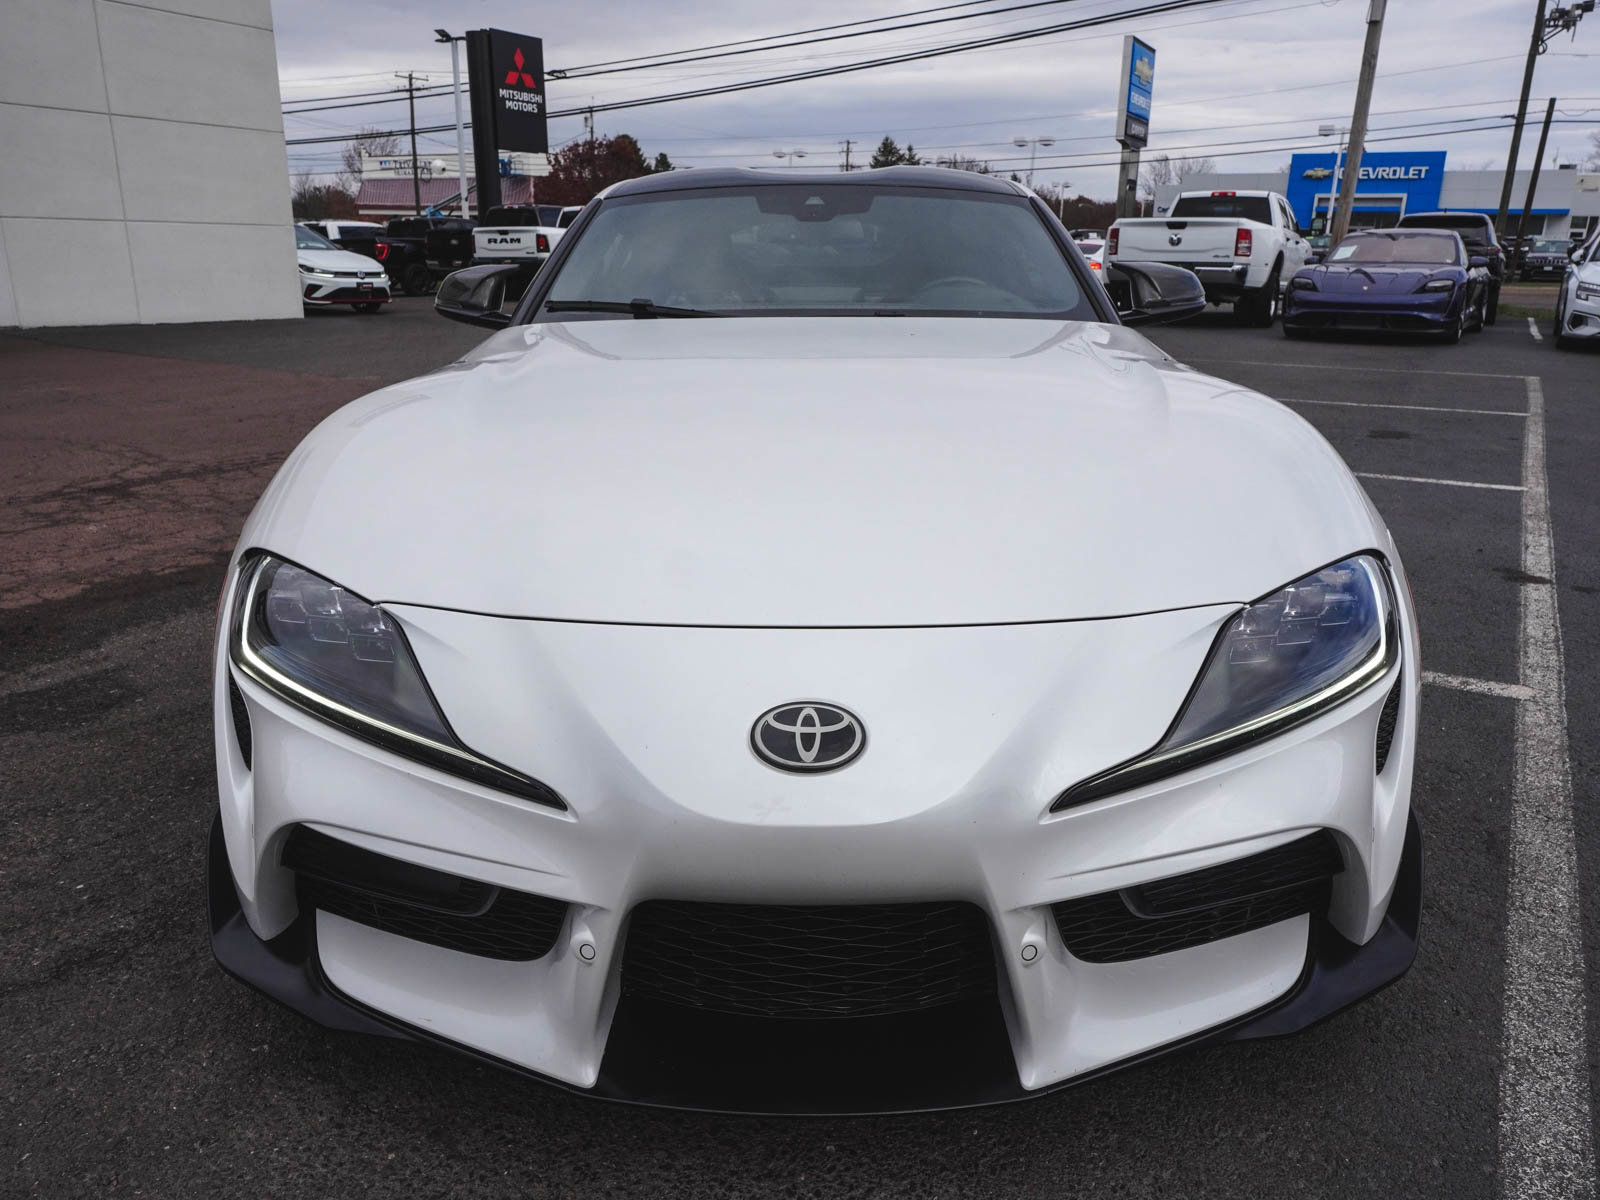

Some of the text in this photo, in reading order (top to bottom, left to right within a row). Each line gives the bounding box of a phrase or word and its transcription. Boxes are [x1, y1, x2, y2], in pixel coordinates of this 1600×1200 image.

[499, 88, 543, 104] MITSUBISHI
[505, 99, 538, 113] MOTORS
[1338, 166, 1429, 180] CEVROLET
